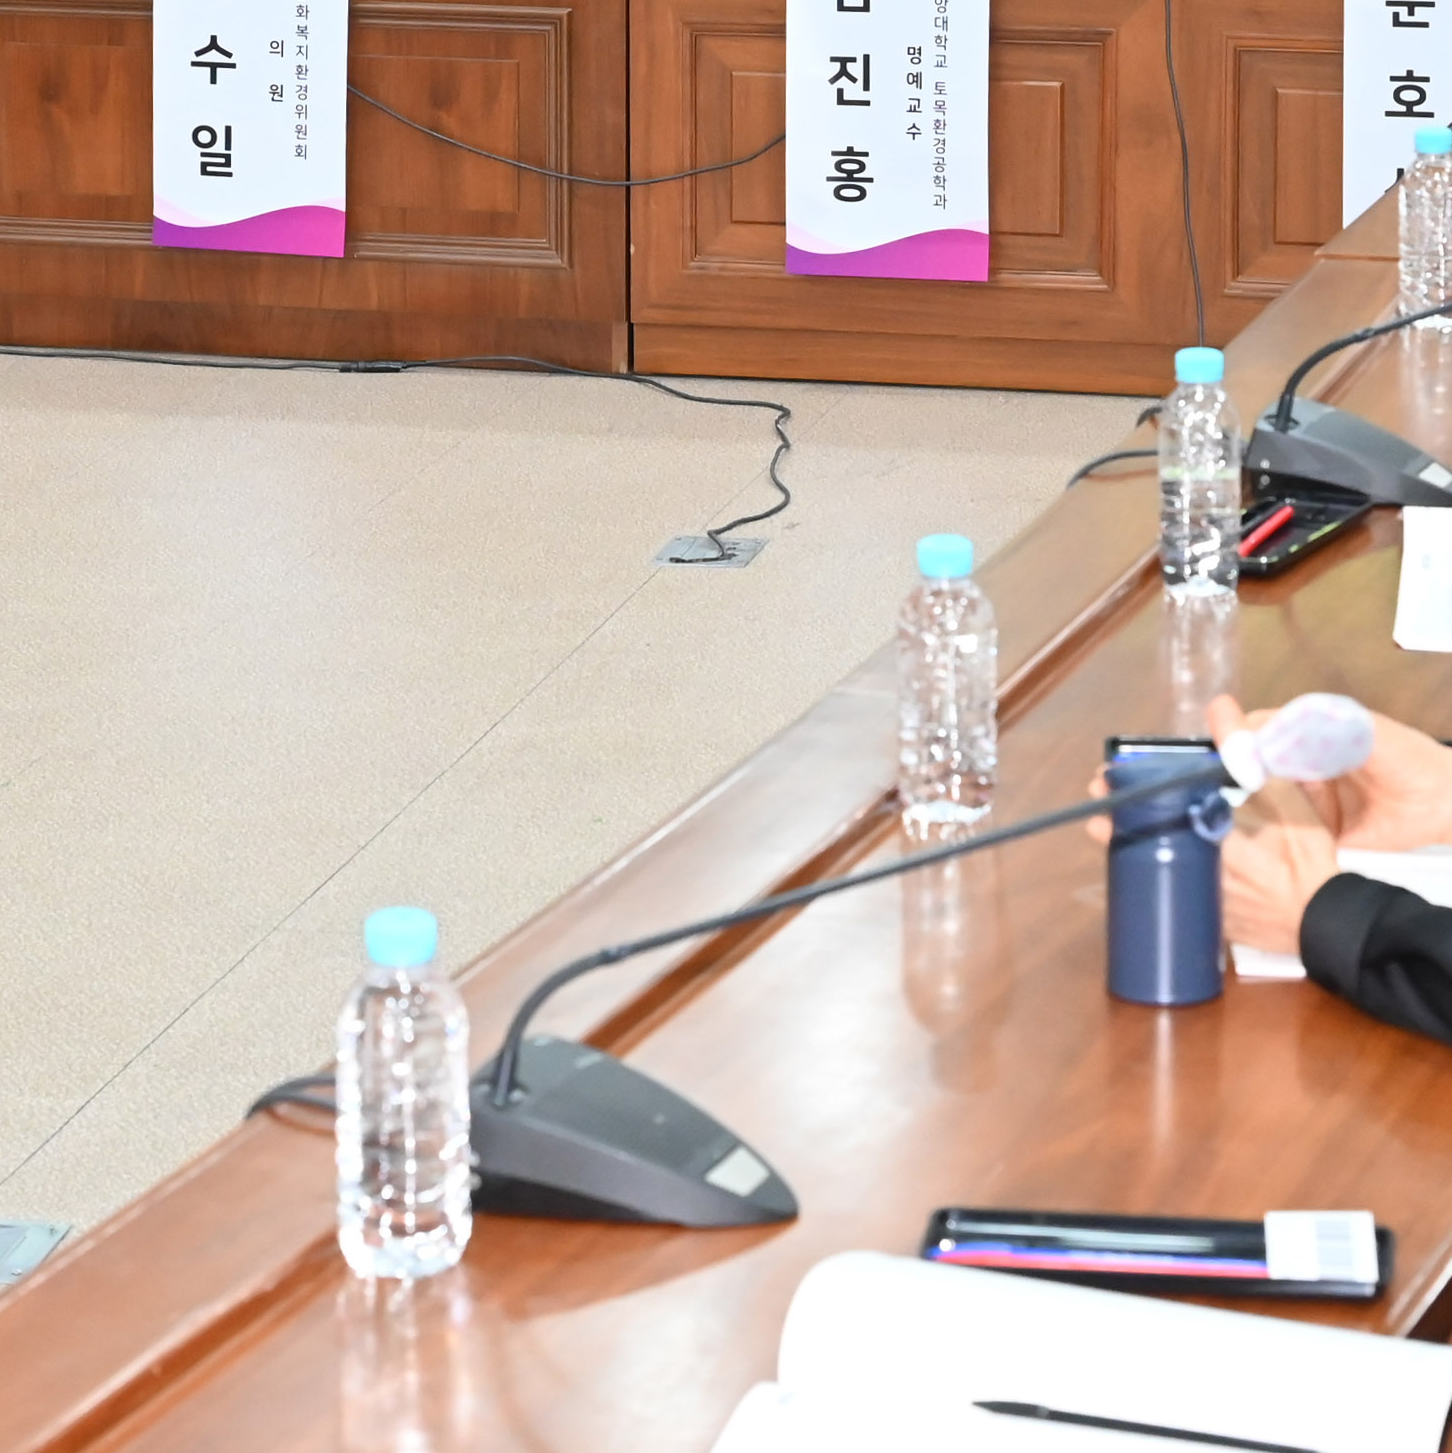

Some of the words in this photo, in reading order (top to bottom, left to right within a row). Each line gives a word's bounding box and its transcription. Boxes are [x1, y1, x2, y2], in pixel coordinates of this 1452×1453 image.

[268, 39, 284, 103] 의원
[905, 45, 923, 141] 명예교수
[932, 81, 947, 210] 토목환경공학과
